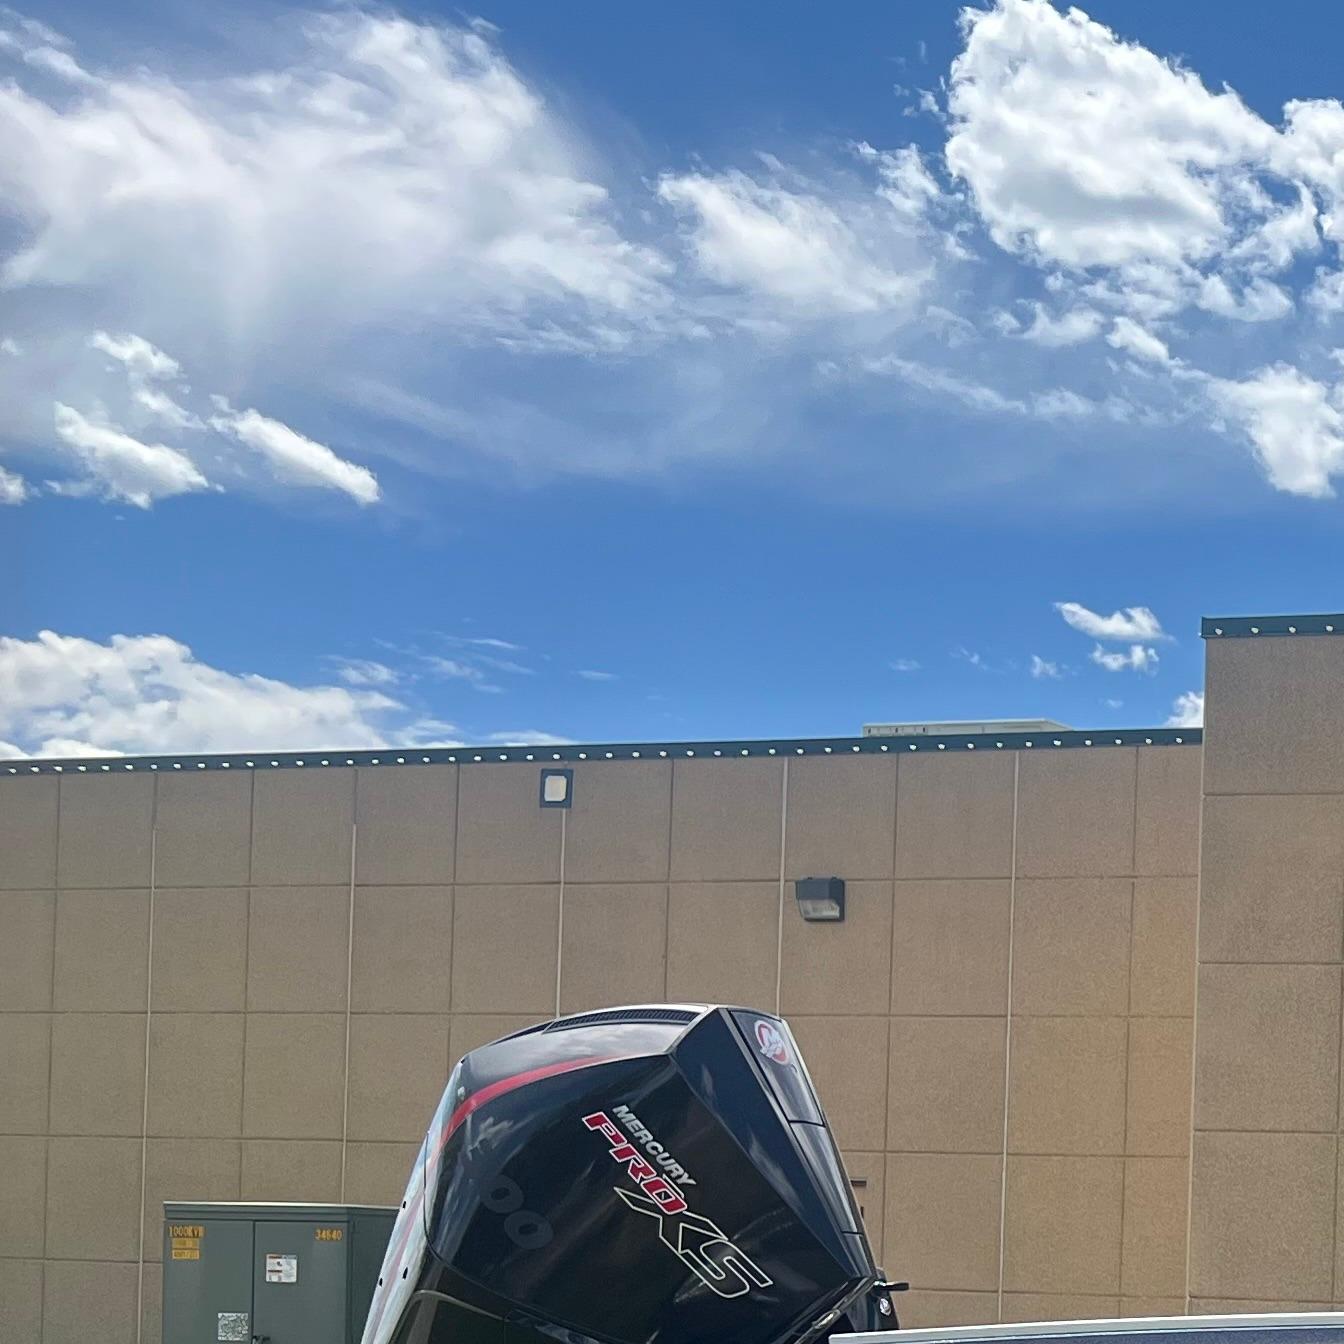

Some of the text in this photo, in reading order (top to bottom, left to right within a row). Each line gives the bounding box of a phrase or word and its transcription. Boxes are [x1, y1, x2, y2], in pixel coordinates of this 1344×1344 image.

[582, 1111, 774, 1298] PRO XS
[612, 1104, 697, 1187] MERCURY
